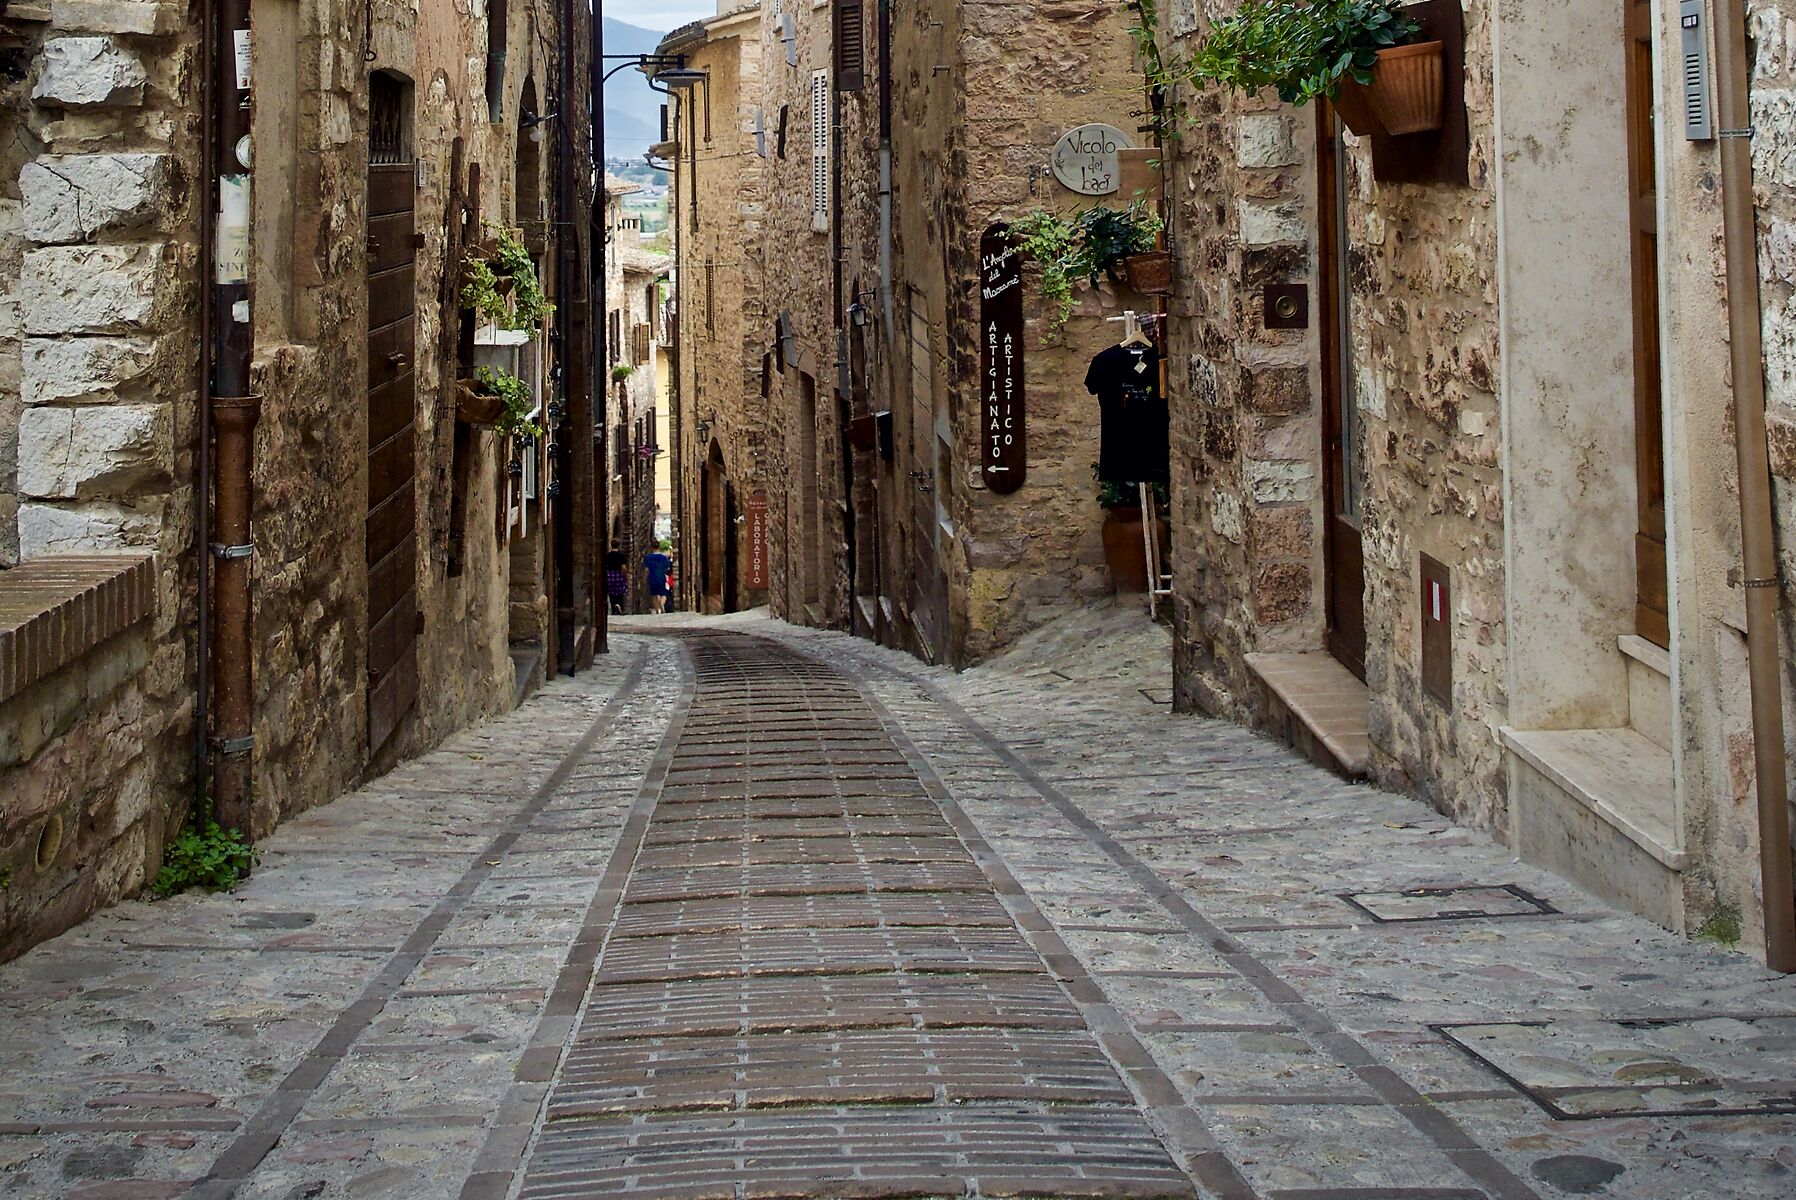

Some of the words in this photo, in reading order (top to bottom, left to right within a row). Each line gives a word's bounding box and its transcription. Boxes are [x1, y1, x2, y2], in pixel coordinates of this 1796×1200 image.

[1067, 130, 1116, 154] Vicolo
[1088, 156, 1103, 174] dei
[1081, 173, 1112, 193] baci
[988, 320, 1001, 458] ARTIGIANATO
[1003, 332, 1014, 446] ARTISTICO
